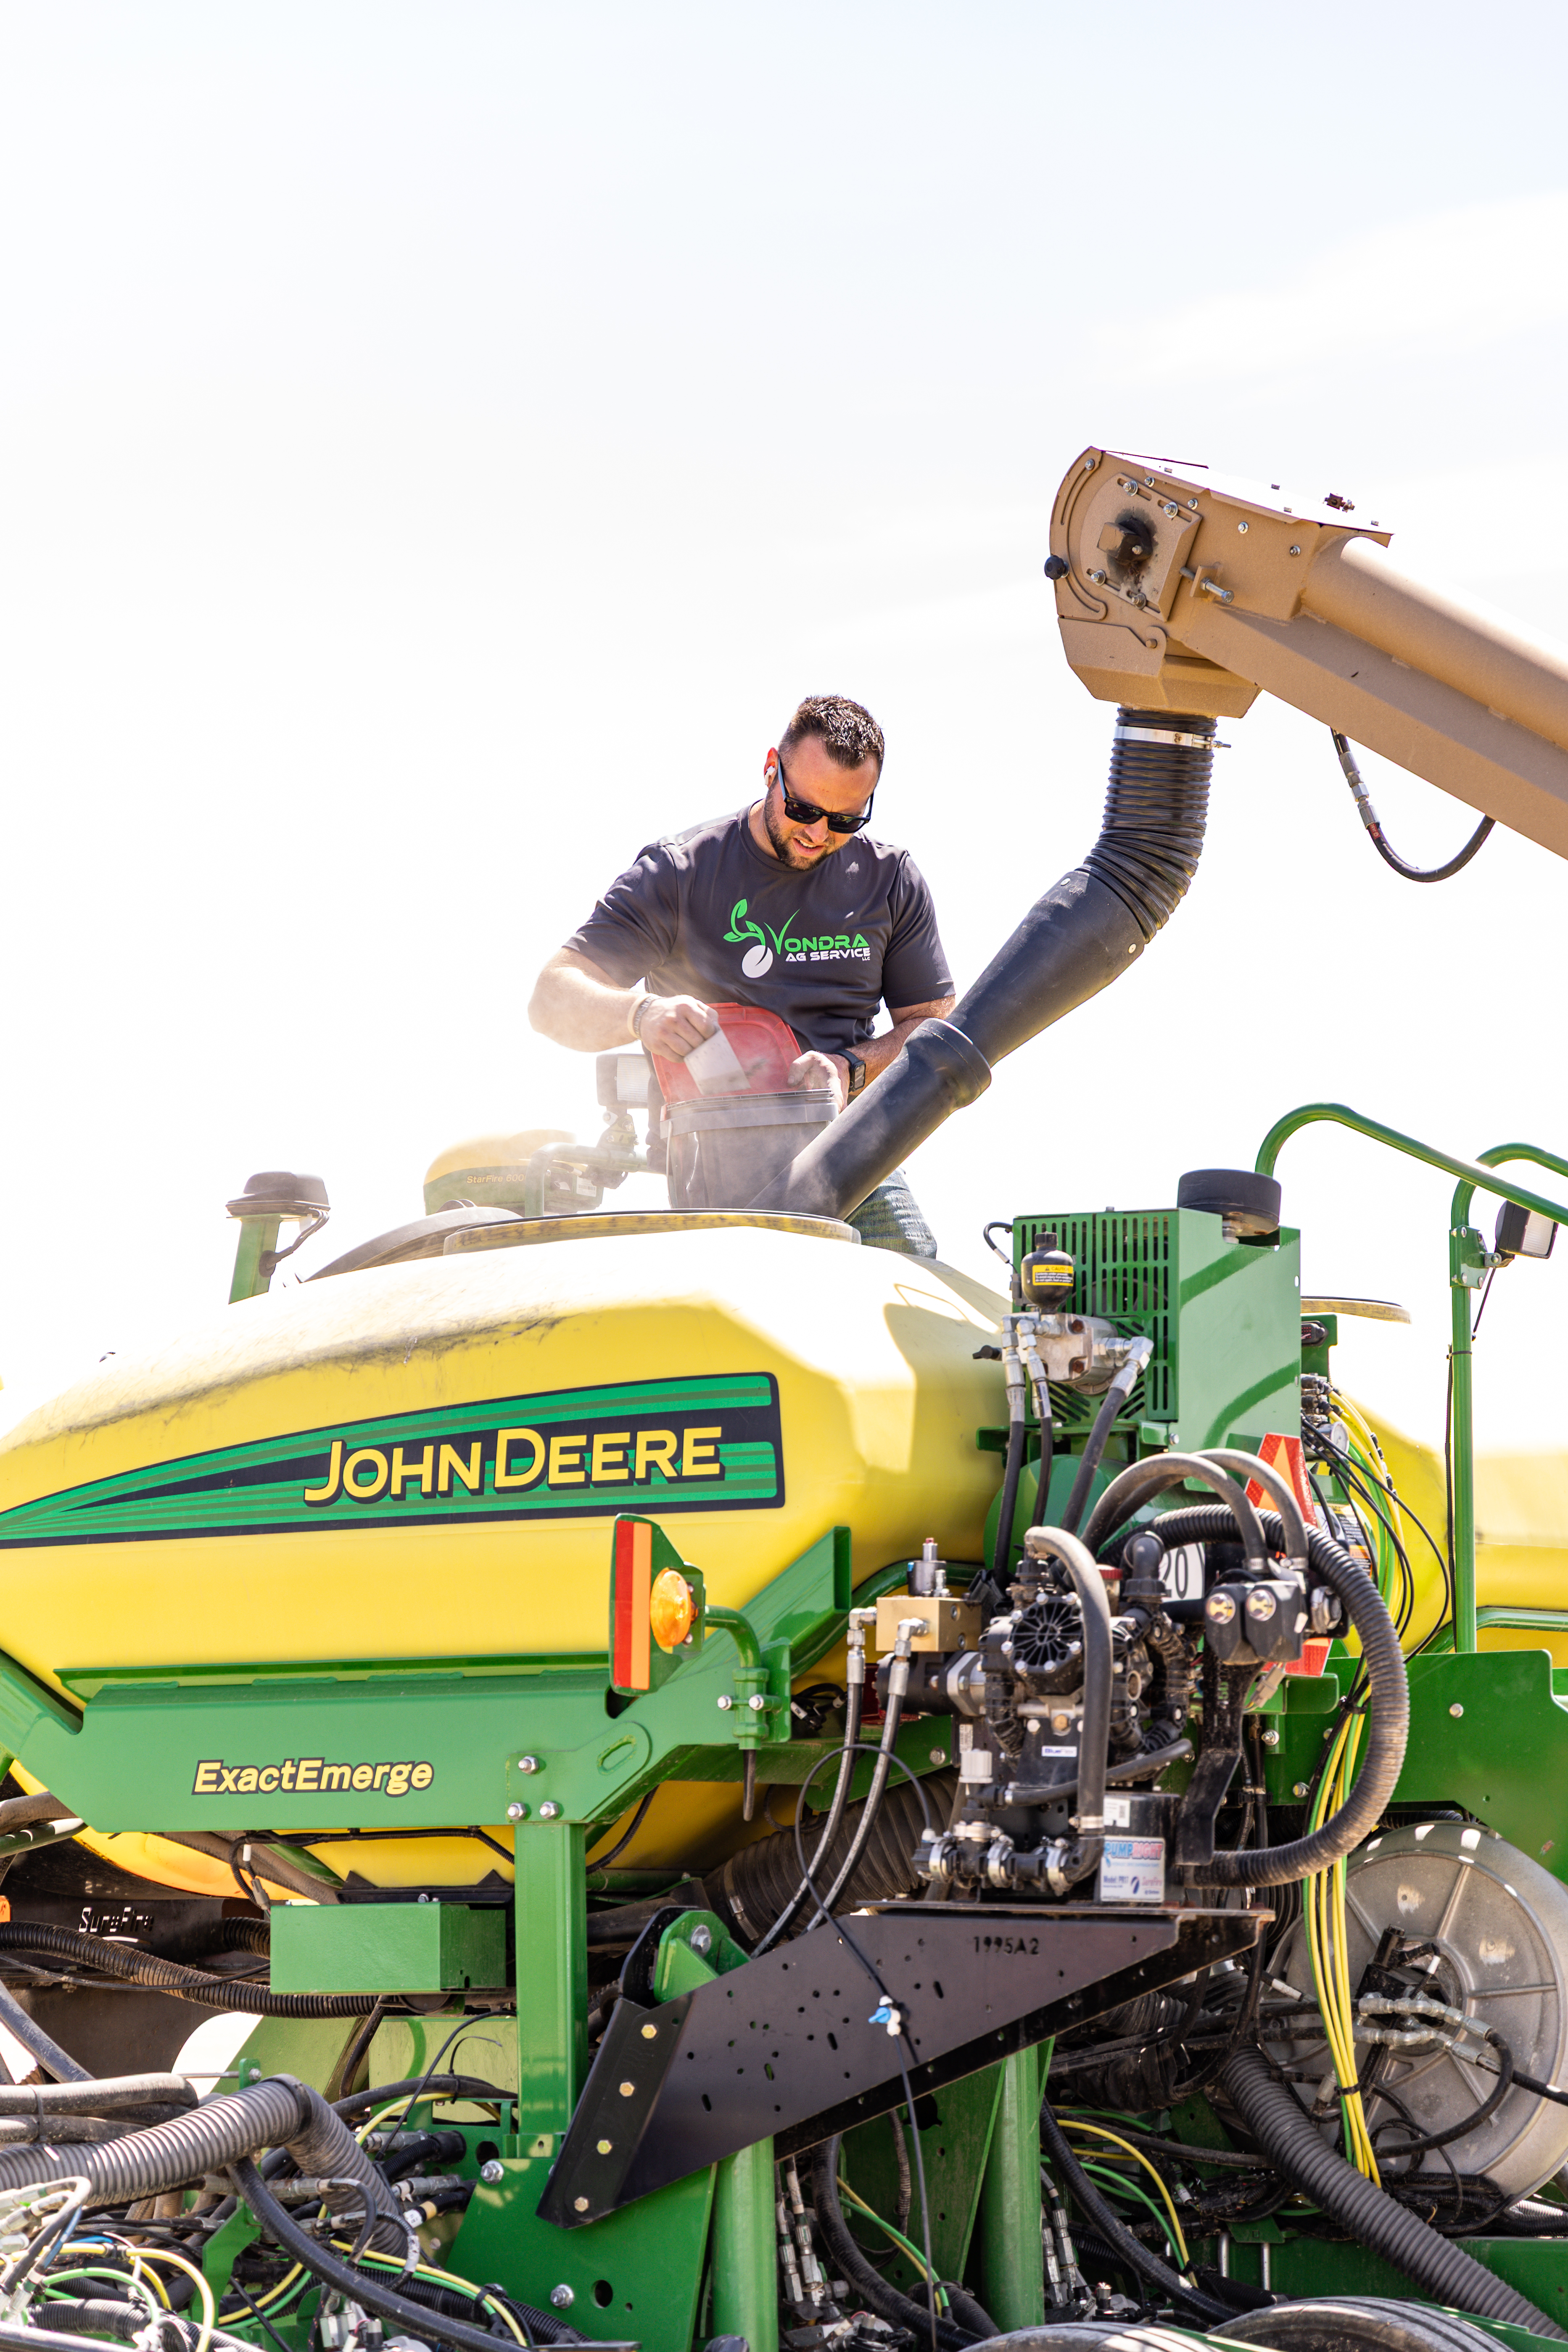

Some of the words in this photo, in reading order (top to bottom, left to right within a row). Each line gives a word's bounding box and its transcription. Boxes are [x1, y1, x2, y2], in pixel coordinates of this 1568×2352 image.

[764, 908, 869, 955] VONDRA
[785, 953, 806, 962] AG
[810, 948, 871, 961] SERVICE
[466, 1175, 503, 1183] StarFire
[304, 1441, 482, 1503] JOHN
[494, 1427, 722, 1488] DEERE
[194, 1759, 433, 1795] ExactEmerge
[1103, 1840, 1163, 1860] PUMPRIGHT
[78, 1907, 154, 1932] SureFire
[974, 1936, 1039, 1954] 1995A2
